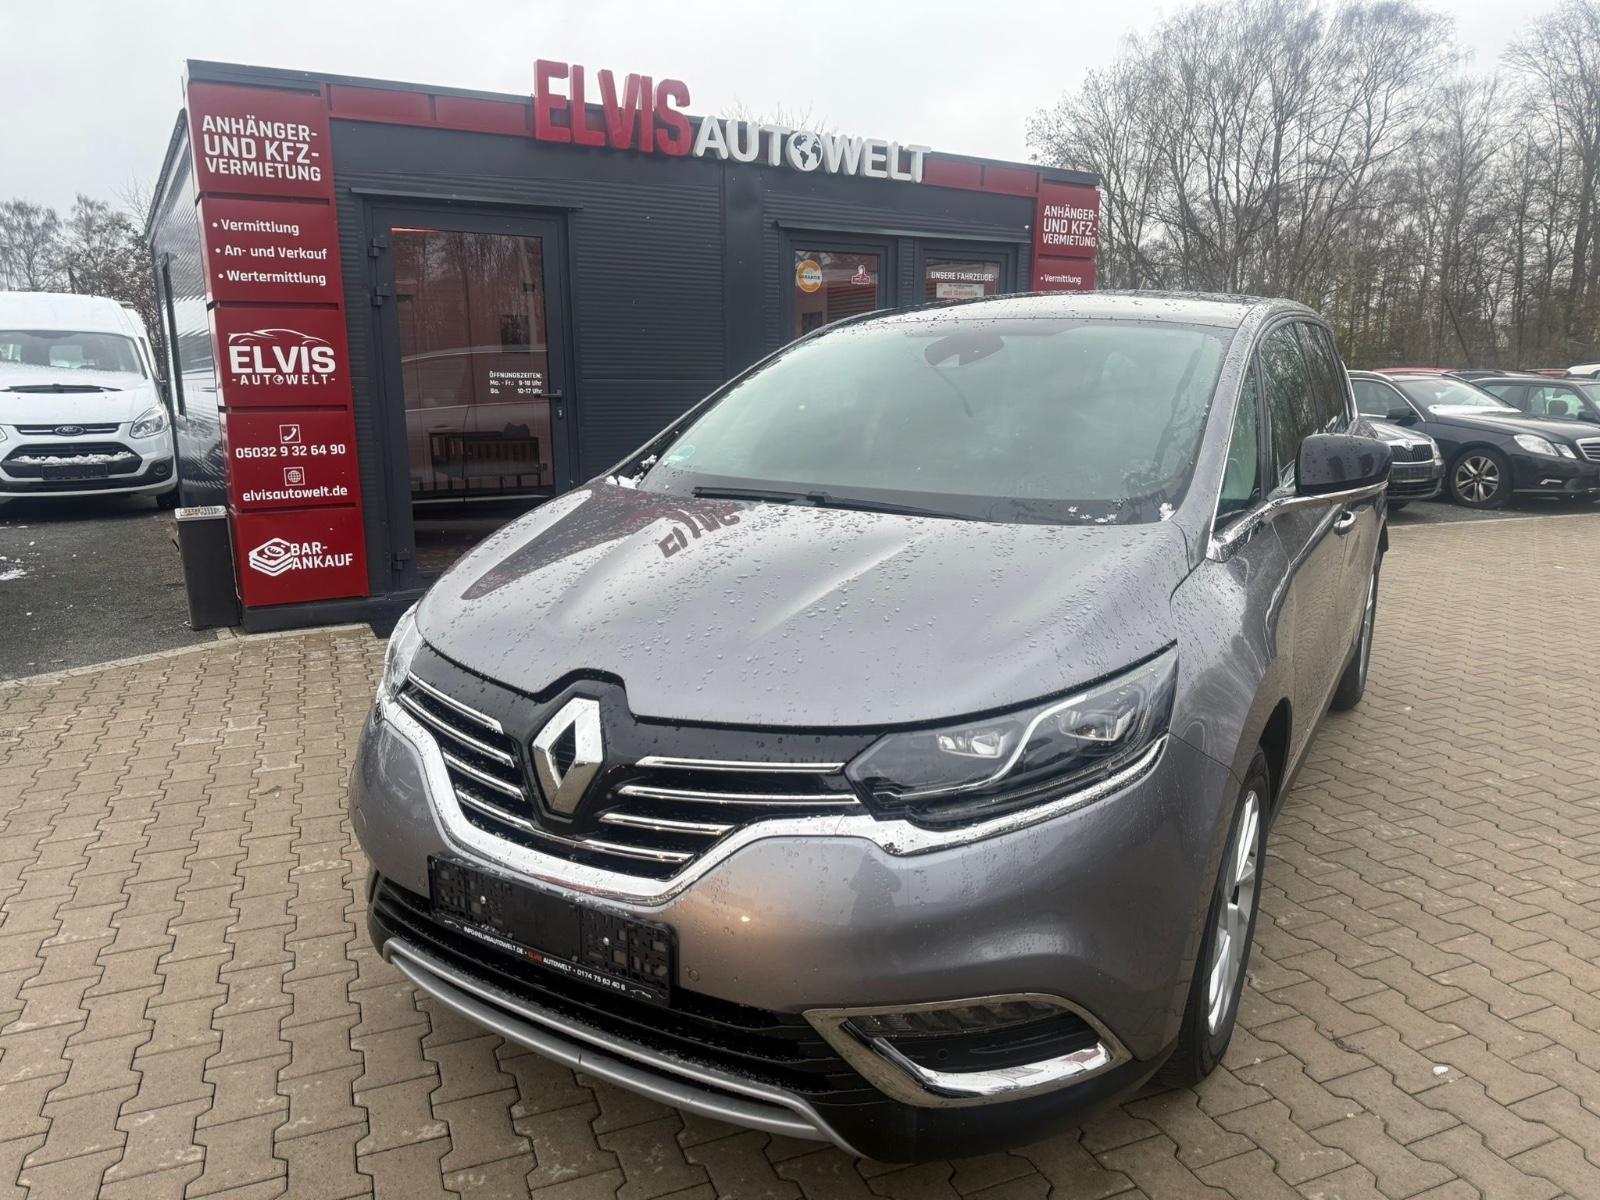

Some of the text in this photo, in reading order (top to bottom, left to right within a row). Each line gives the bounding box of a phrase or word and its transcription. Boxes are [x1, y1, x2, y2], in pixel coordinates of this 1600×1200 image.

[202, 114, 317, 142] ANHÄNGER-
[533, 58, 931, 183] ELVIS AUTOWELT
[204, 134, 319, 164] UND KFZ-
[205, 157, 321, 182] VERMIETUNG
[1044, 204, 1097, 221] ANHÄNGER-
[221, 219, 299, 236] Vermittlung
[1043, 218, 1096, 236] UND KFZ-
[1042, 233, 1096, 247] VERMIETUNG
[224, 244, 327, 260] An- und Verkauf
[227, 270, 326, 286] Wertermittlung
[931, 271, 956, 280] UNSERE
[1044, 274, 1082, 285] Vermittlung
[228, 345, 336, 374] ELVIS
[235, 444, 346, 458] 05032 9 32 64 90
[242, 485, 348, 502] elvisautowelt.de
[290, 541, 328, 556] BAR-
[291, 553, 353, 570] ANKAUF
